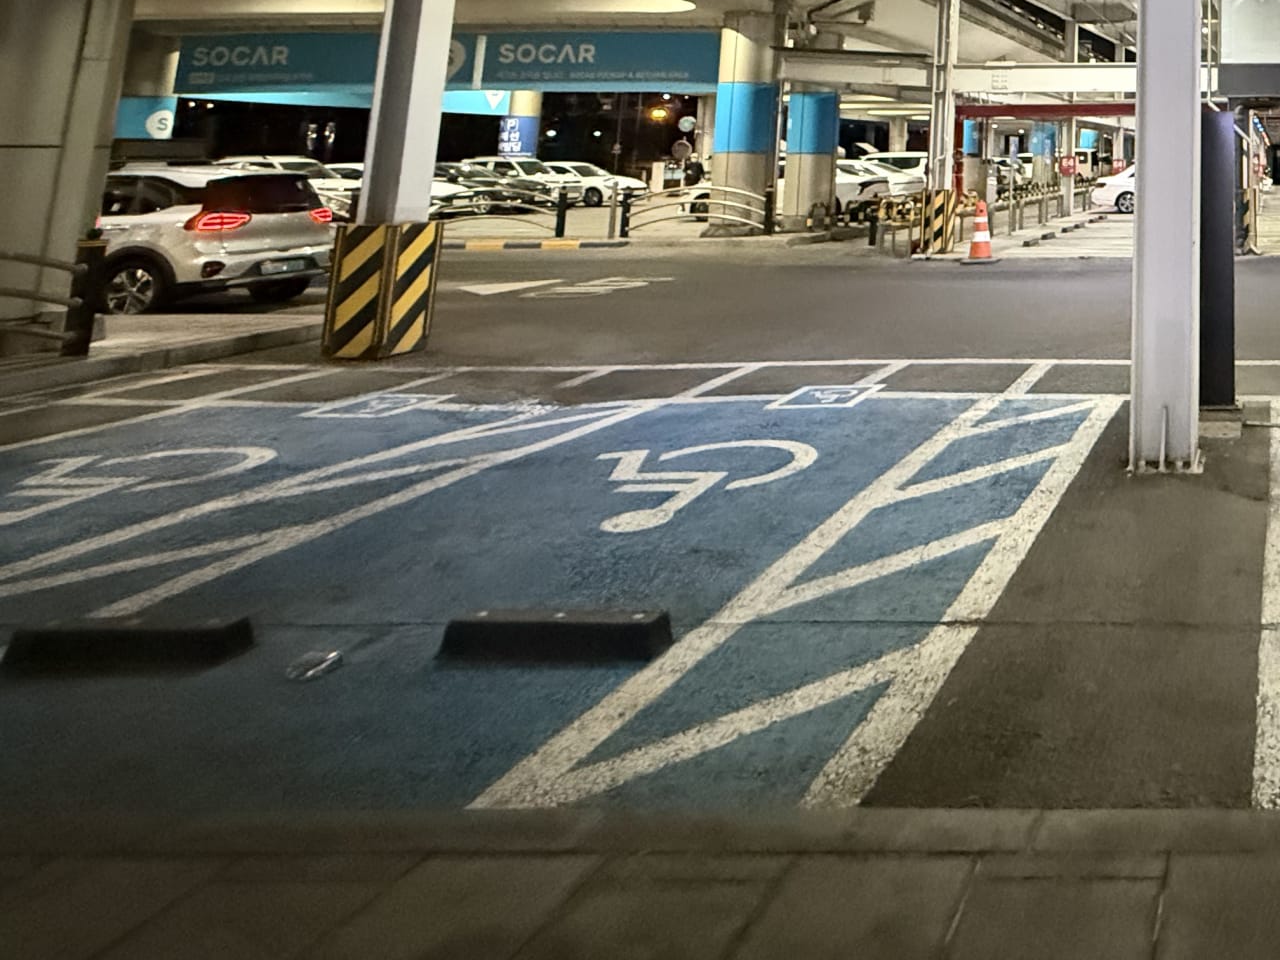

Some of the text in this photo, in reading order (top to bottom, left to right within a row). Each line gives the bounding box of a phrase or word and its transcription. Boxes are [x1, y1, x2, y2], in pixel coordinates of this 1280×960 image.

[191, 46, 289, 66] SOCAR
[498, 43, 596, 64] SOCAR
[157, 118, 168, 130] S
